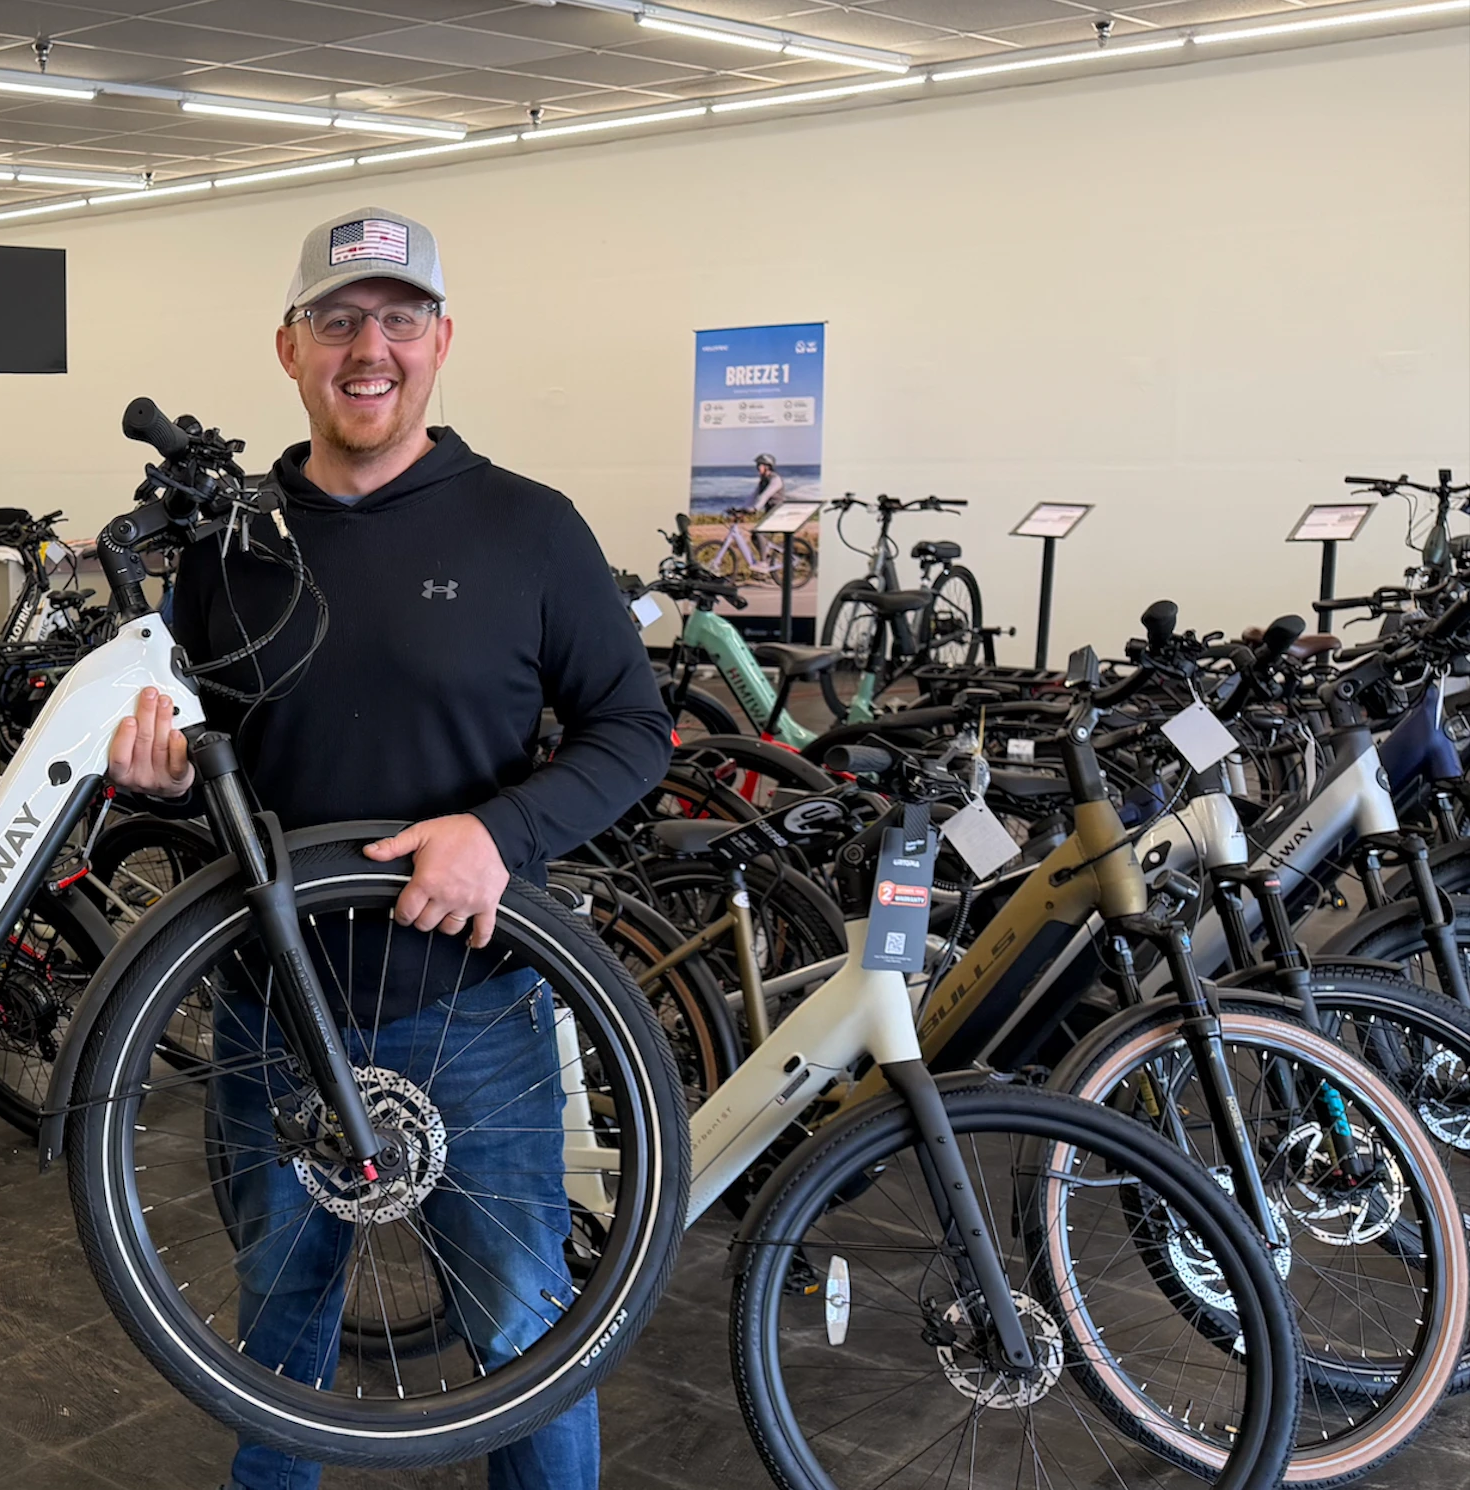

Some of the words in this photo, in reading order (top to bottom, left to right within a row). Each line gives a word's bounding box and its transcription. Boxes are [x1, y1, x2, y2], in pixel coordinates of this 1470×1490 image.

[725, 364, 779, 386] BREEZE
[781, 363, 790, 384] 1
[881, 886, 893, 901] 2
[918, 927, 1017, 1038] BULLS
[579, 1308, 629, 1368] KENDA
